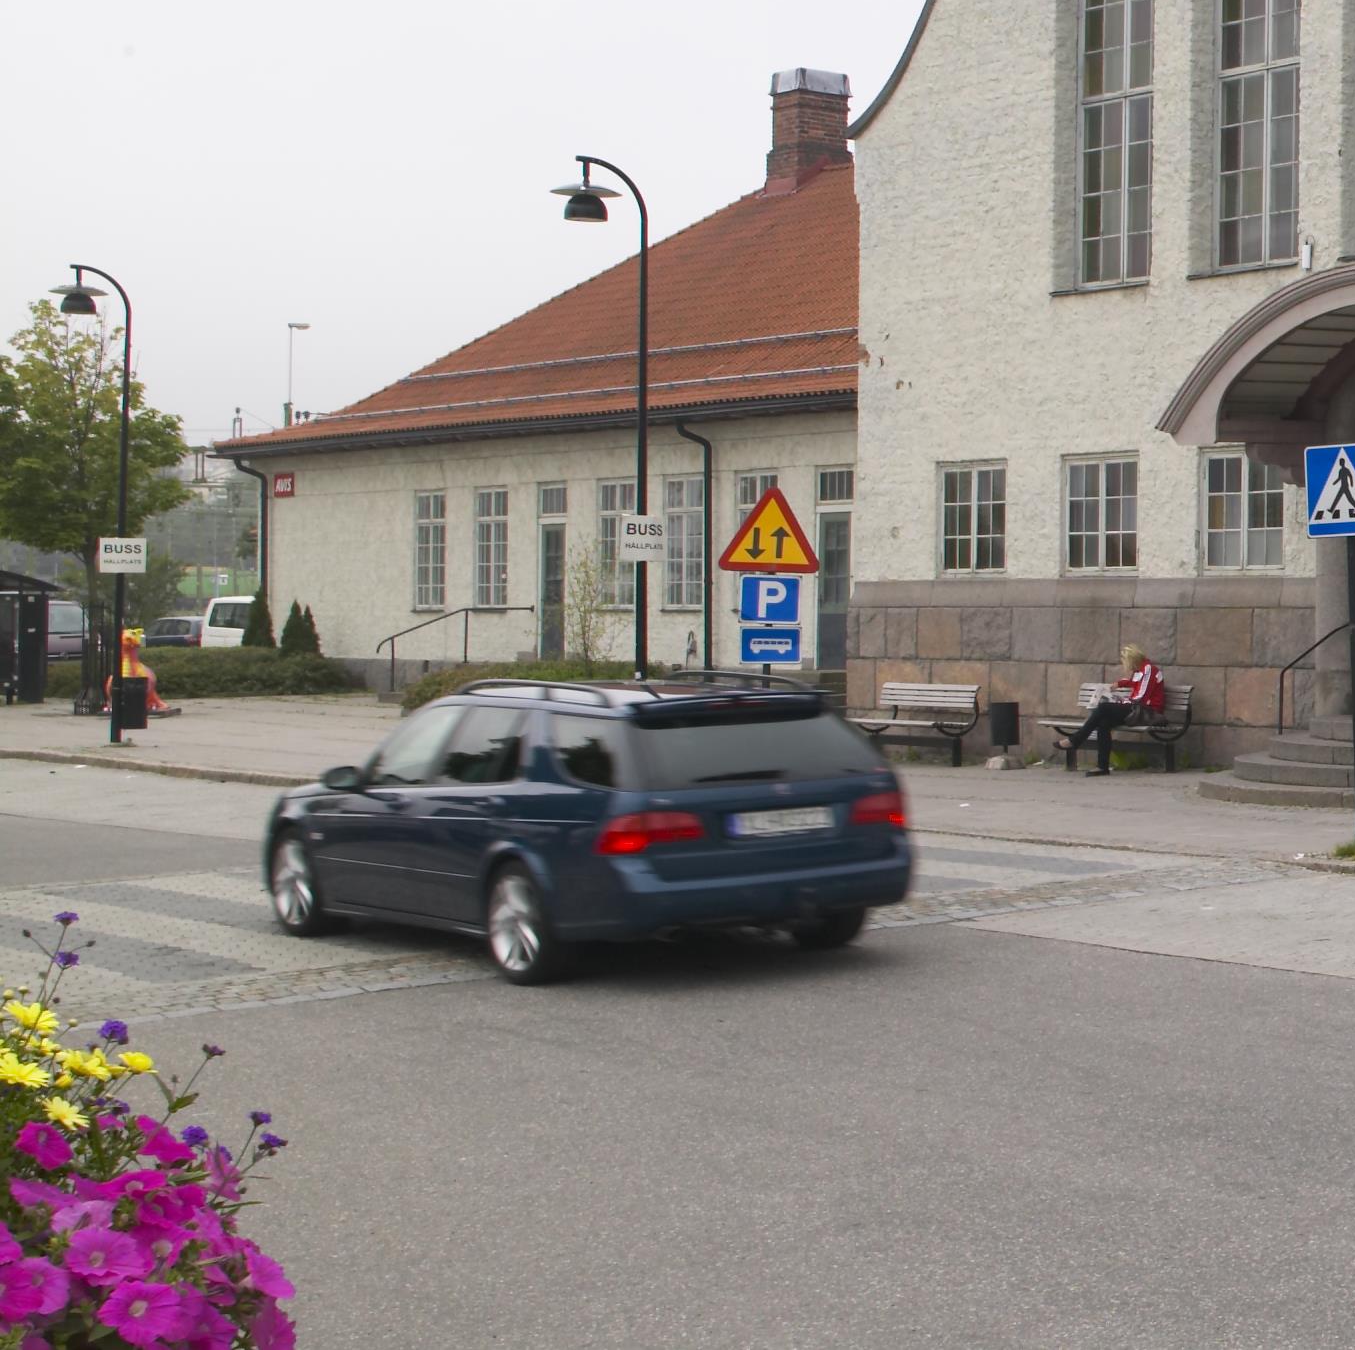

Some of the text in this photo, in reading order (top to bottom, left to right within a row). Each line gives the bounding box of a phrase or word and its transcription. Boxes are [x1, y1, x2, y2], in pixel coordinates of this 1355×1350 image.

[275, 478, 292, 492] AVIS
[627, 523, 663, 536] BUSS
[104, 544, 142, 554] BUSS
[757, 581, 787, 618] P
